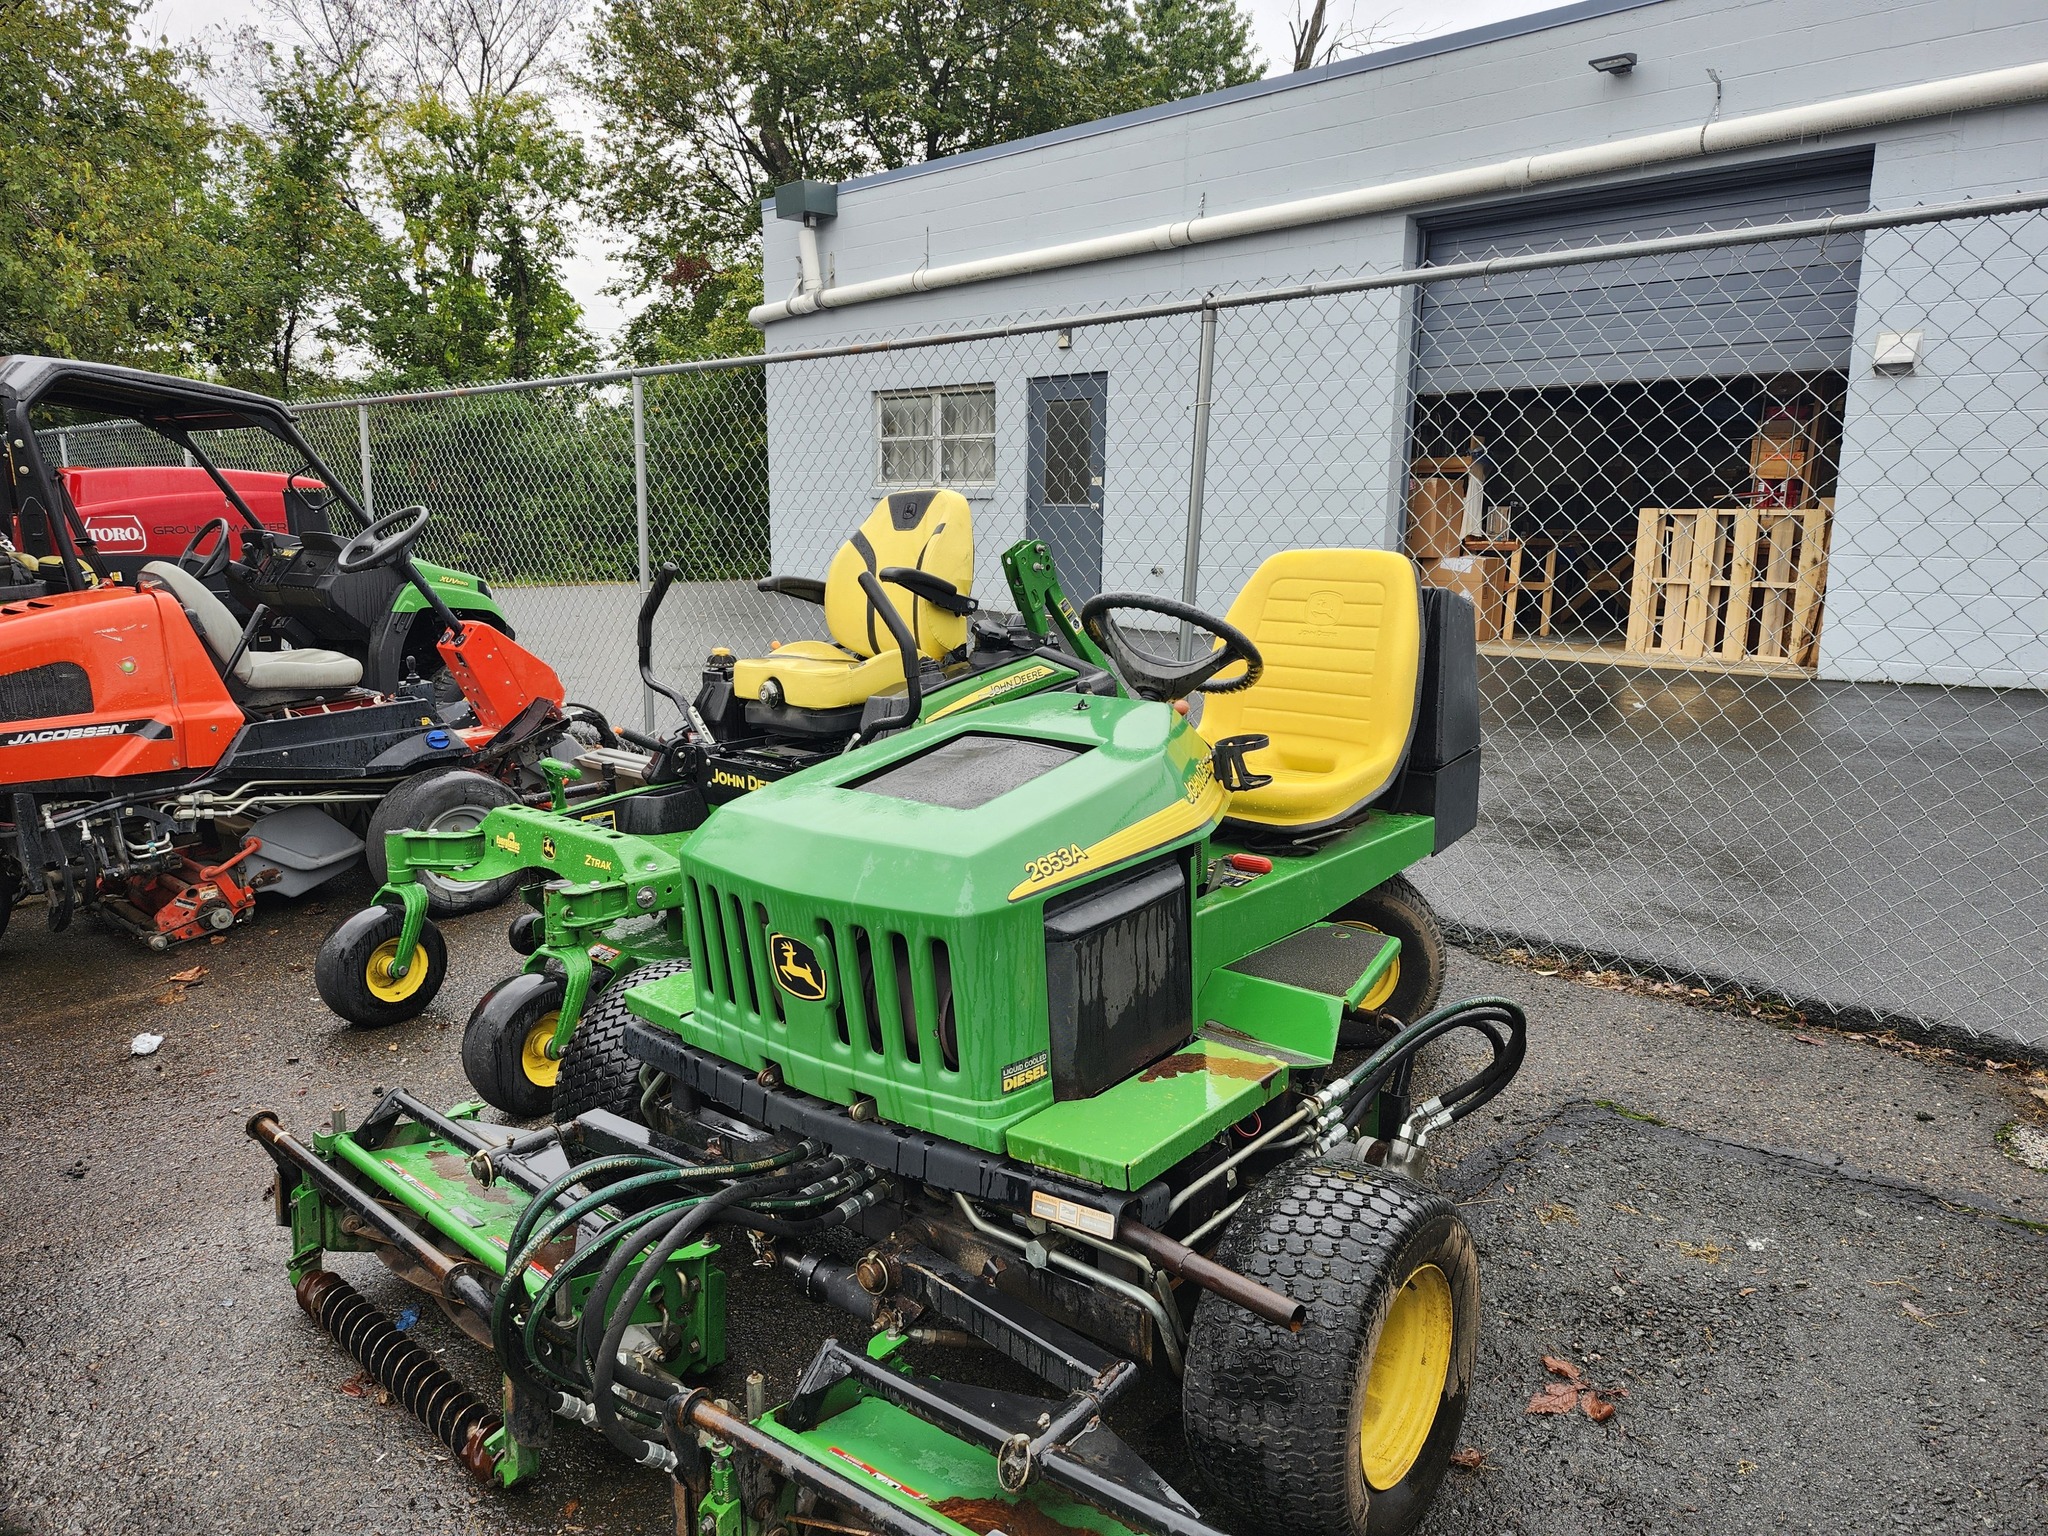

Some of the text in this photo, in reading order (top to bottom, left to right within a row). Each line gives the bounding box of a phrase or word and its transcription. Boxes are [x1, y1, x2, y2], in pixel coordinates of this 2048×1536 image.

[87, 527, 140, 542] TORO
[989, 668, 1045, 697] JOHN DEERE
[7, 724, 126, 745] JACOBSEN
[711, 768, 746, 789] JOHN
[1024, 843, 1088, 882] 2653A
[1003, 1053, 1047, 1076] LIQUID COOLED
[1003, 1064, 1048, 1092] DIESEL
[595, 1162, 612, 1172] BAR
[680, 1165, 735, 1177] Weatherhead
[504, 1267, 517, 1284] 345
[514, 1249, 531, 1266] BAR
[529, 1227, 551, 1249] (5000
